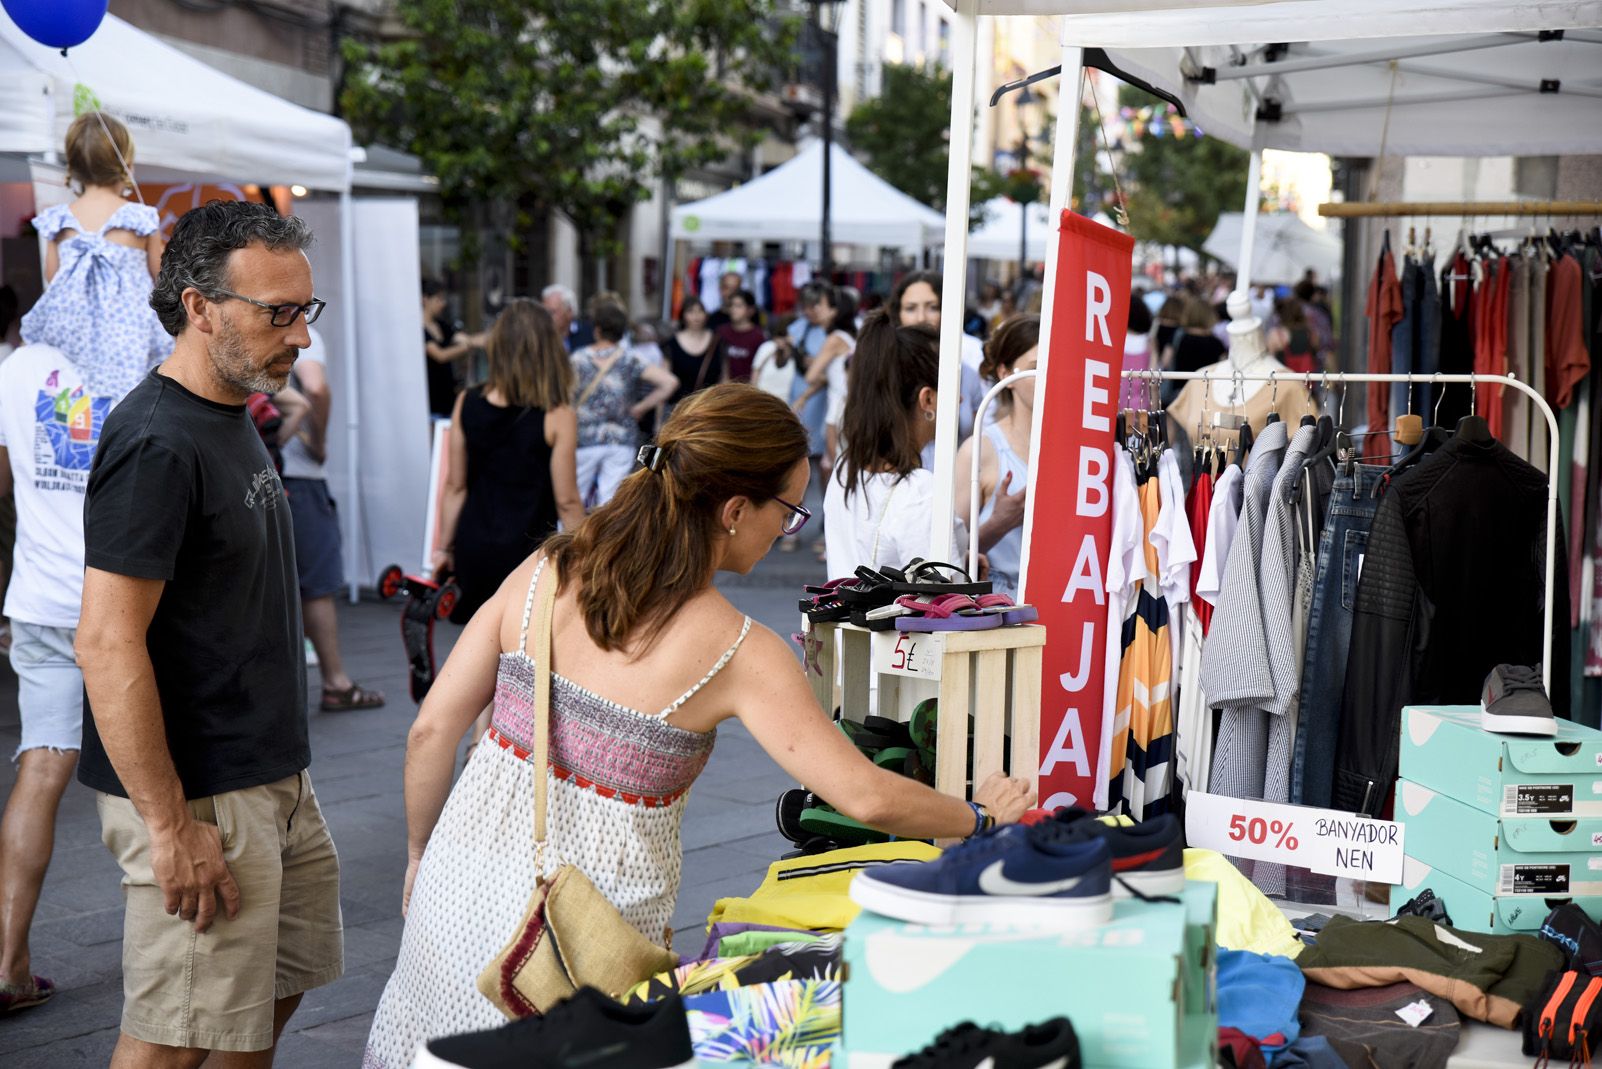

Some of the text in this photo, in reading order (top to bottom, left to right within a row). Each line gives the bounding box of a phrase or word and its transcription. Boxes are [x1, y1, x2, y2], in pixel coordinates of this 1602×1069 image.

[1228, 814, 1299, 851] 50%
[1315, 818, 1398, 846] BANYADOR
[1336, 847, 1374, 871] NEN
